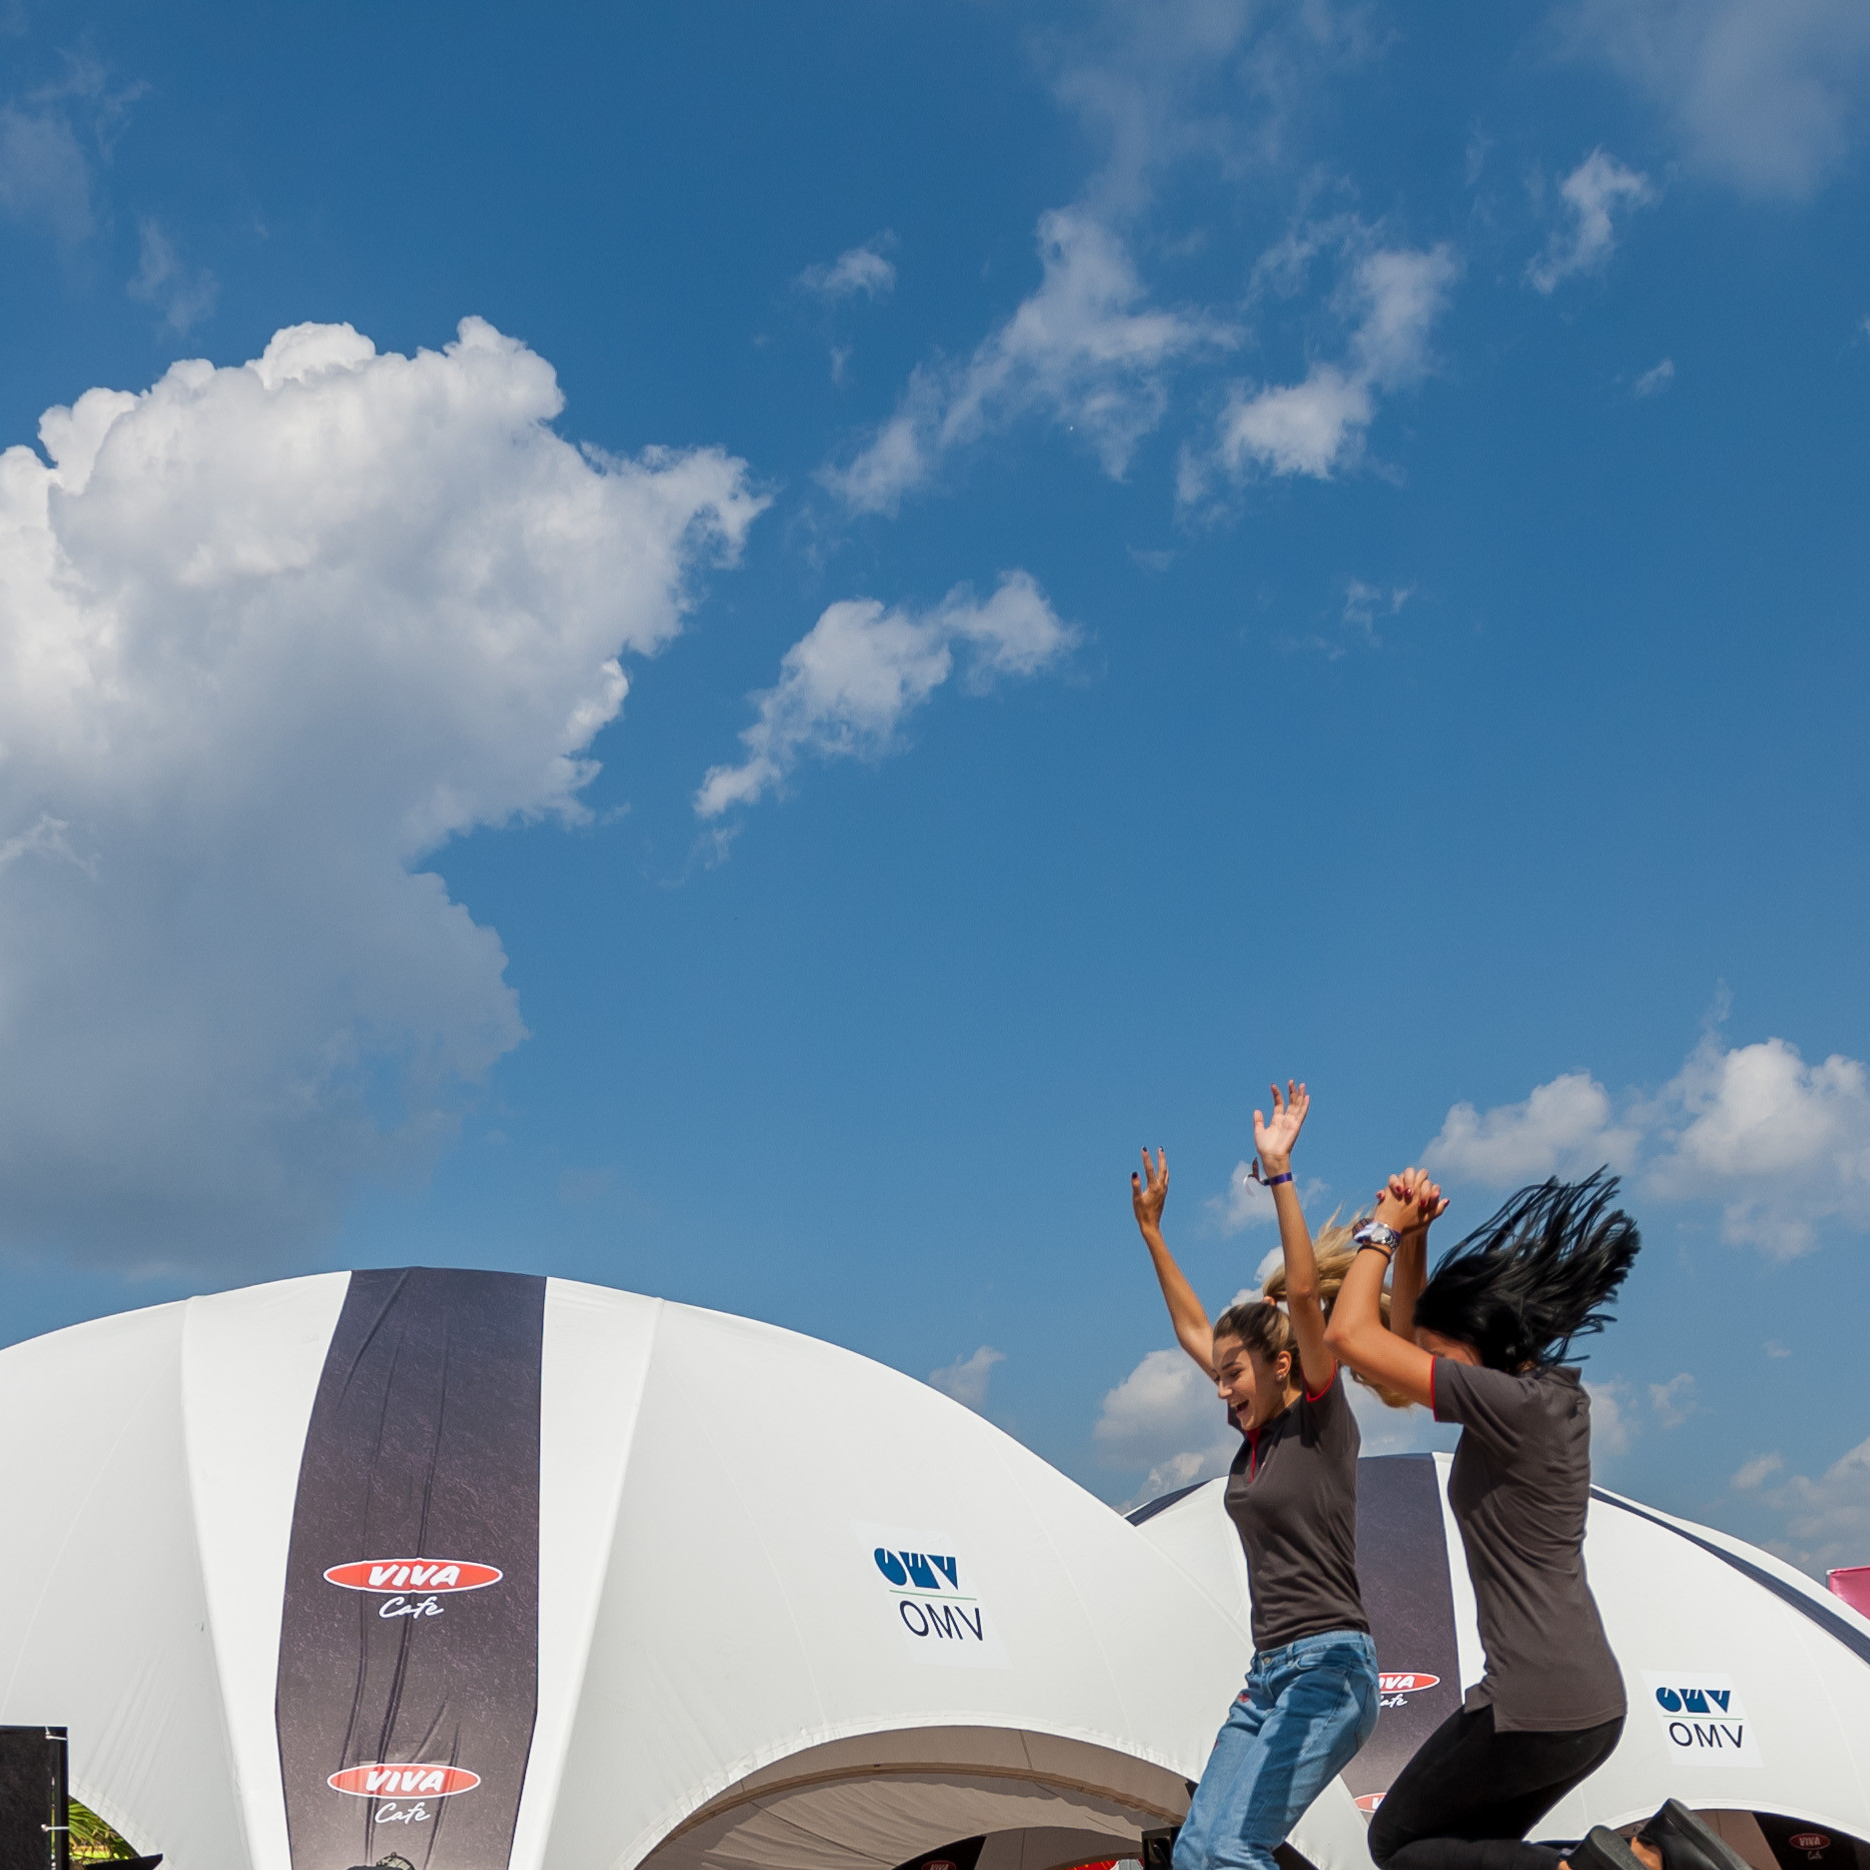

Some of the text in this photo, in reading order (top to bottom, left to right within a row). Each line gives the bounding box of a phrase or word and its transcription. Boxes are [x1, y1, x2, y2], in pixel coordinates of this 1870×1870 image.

[368, 1564, 461, 1588] VIVA
[900, 1600, 983, 1641] OMV
[1669, 1722, 1743, 1748] OMV
[365, 1769, 446, 1792] VIVA
